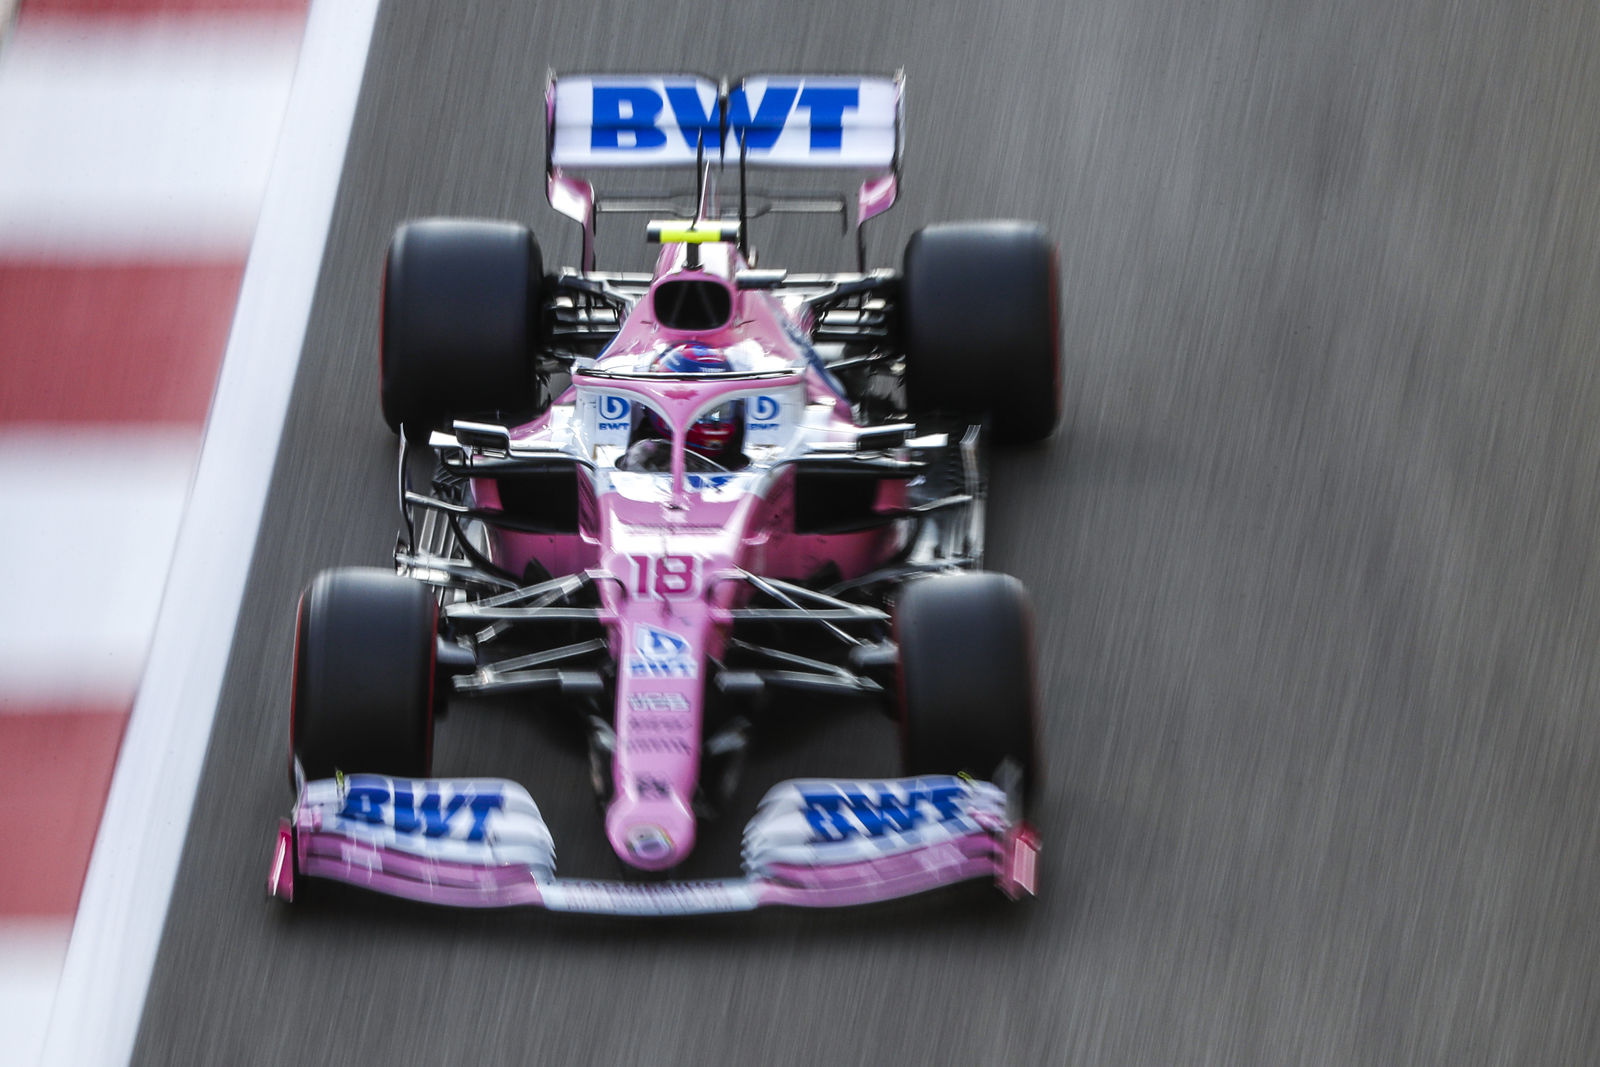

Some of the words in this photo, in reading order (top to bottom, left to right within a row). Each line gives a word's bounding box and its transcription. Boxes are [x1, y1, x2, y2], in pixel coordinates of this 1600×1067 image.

[590, 86, 860, 154] BWT
[598, 422, 630, 430] BWT
[630, 554, 695, 594] 18
[337, 775, 504, 842] BWT
